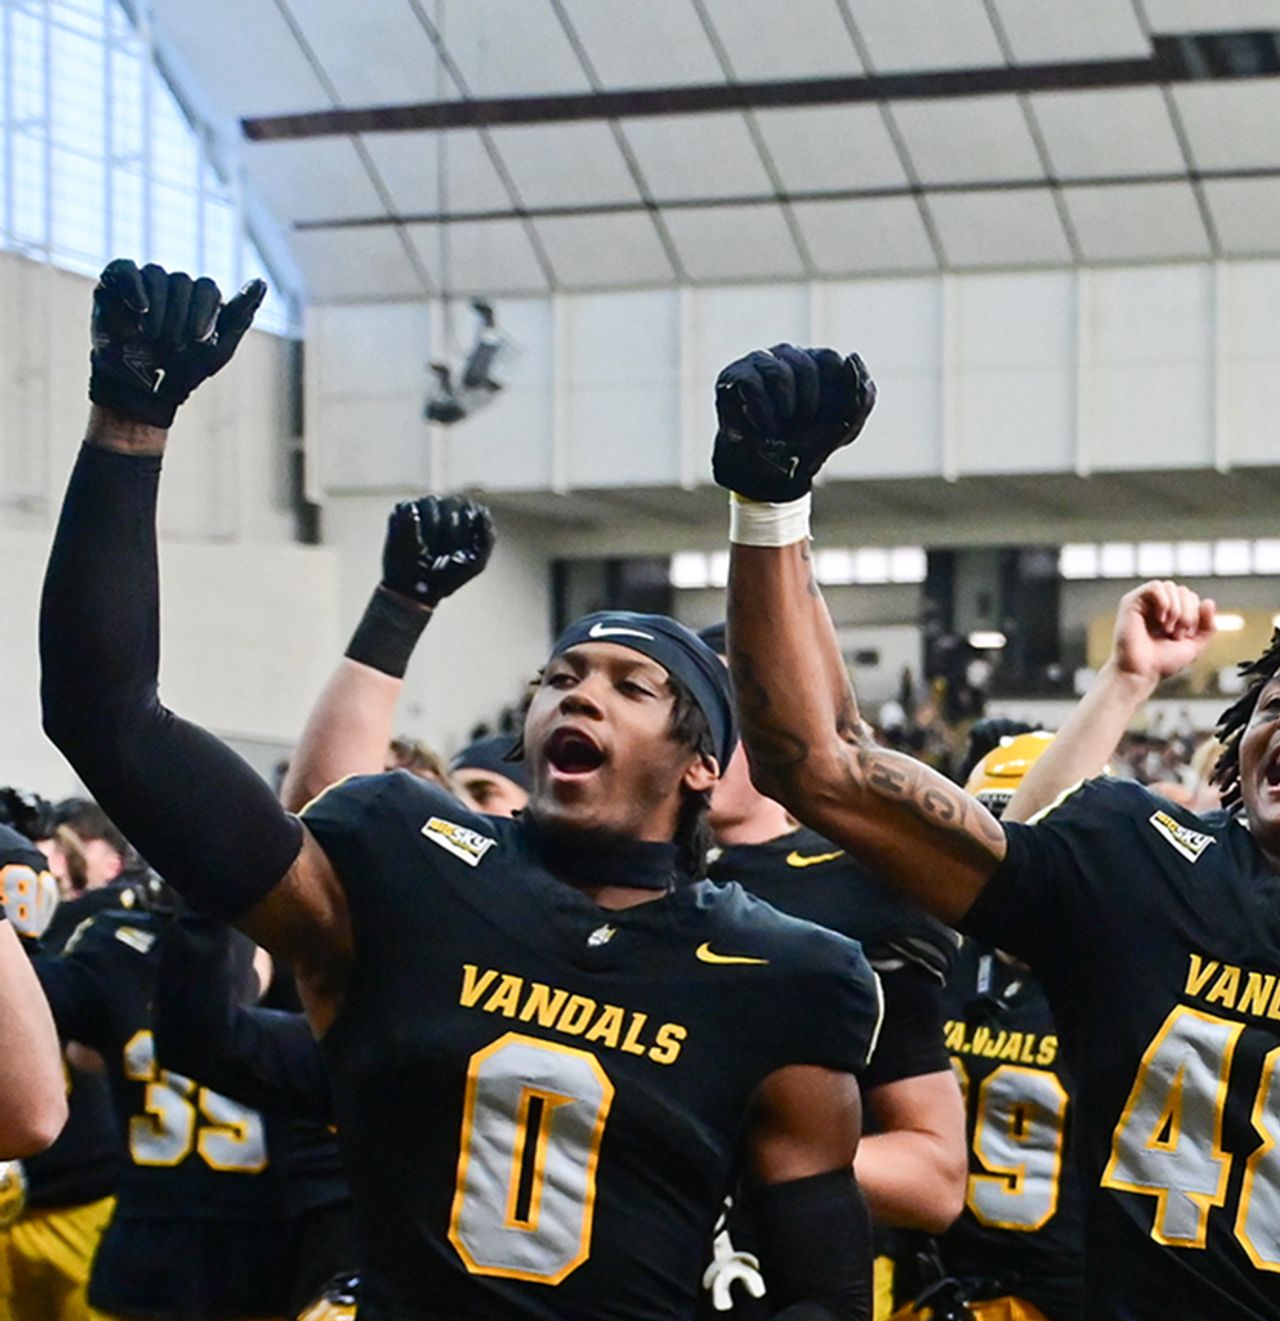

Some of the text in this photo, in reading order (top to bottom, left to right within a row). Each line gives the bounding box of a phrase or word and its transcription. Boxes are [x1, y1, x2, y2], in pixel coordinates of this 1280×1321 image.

[459, 963, 688, 1066] VANDALS
[447, 1031, 616, 1288] 0
[950, 1056, 1069, 1232] 9
